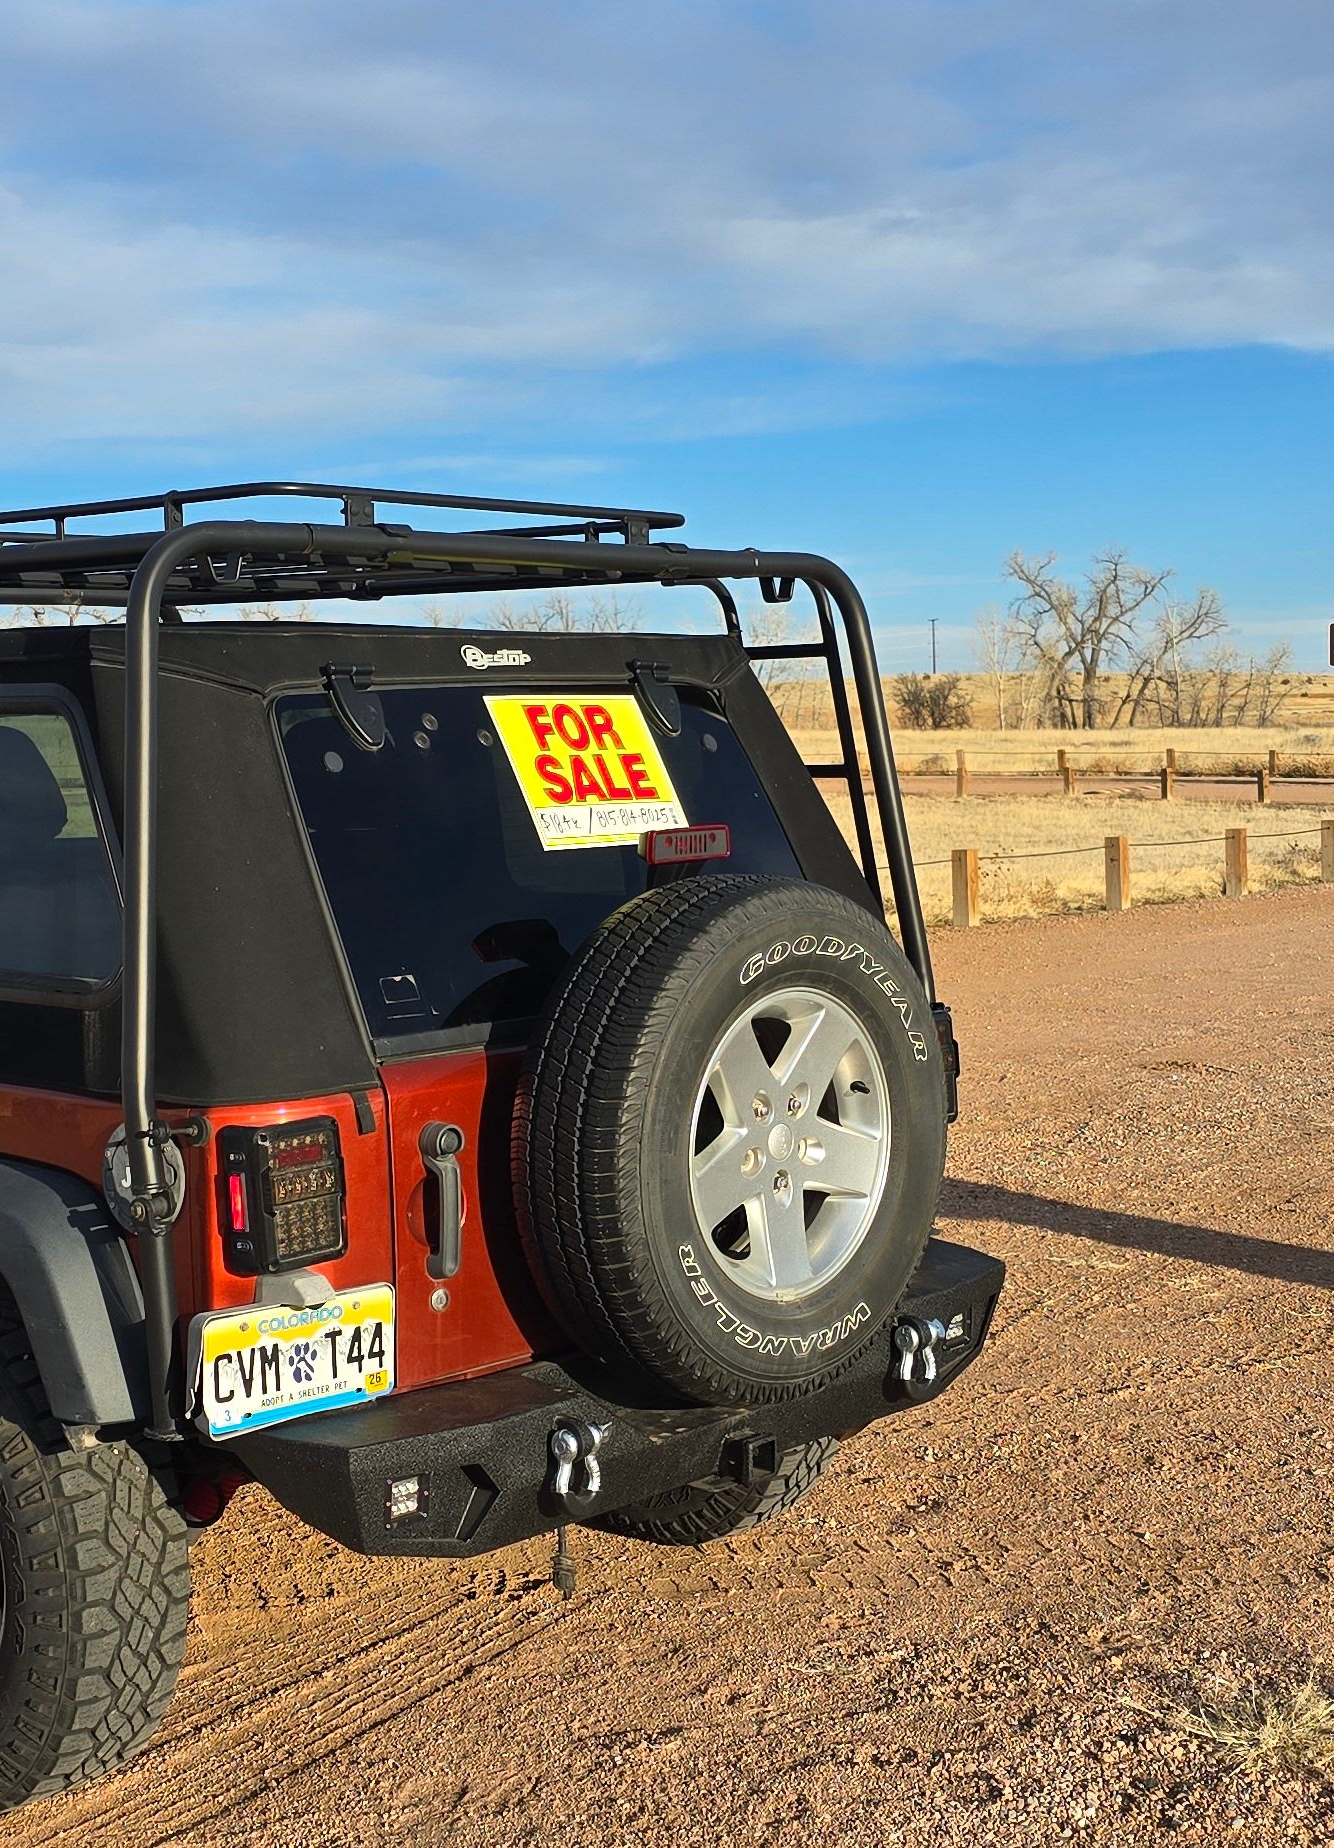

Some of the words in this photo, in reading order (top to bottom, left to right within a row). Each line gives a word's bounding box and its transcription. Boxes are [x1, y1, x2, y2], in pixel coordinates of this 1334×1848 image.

[522, 703, 626, 751] FOR
[535, 753, 660, 804] SALE
[739, 935, 928, 1062] GOODYEAR
[257, 1304, 344, 1335] COLORADO
[678, 1244, 872, 1358] WRANGLER
[213, 1342, 282, 1404] CVM
[324, 1321, 386, 1380] T44
[368, 1372, 382, 1386] 26
[223, 1409, 233, 1423] 3
[261, 1395, 285, 1408] ADOPT
[288, 1392, 295, 1402] A
[298, 1384, 331, 1400] SHELTER
[334, 1380, 348, 1392] PET
